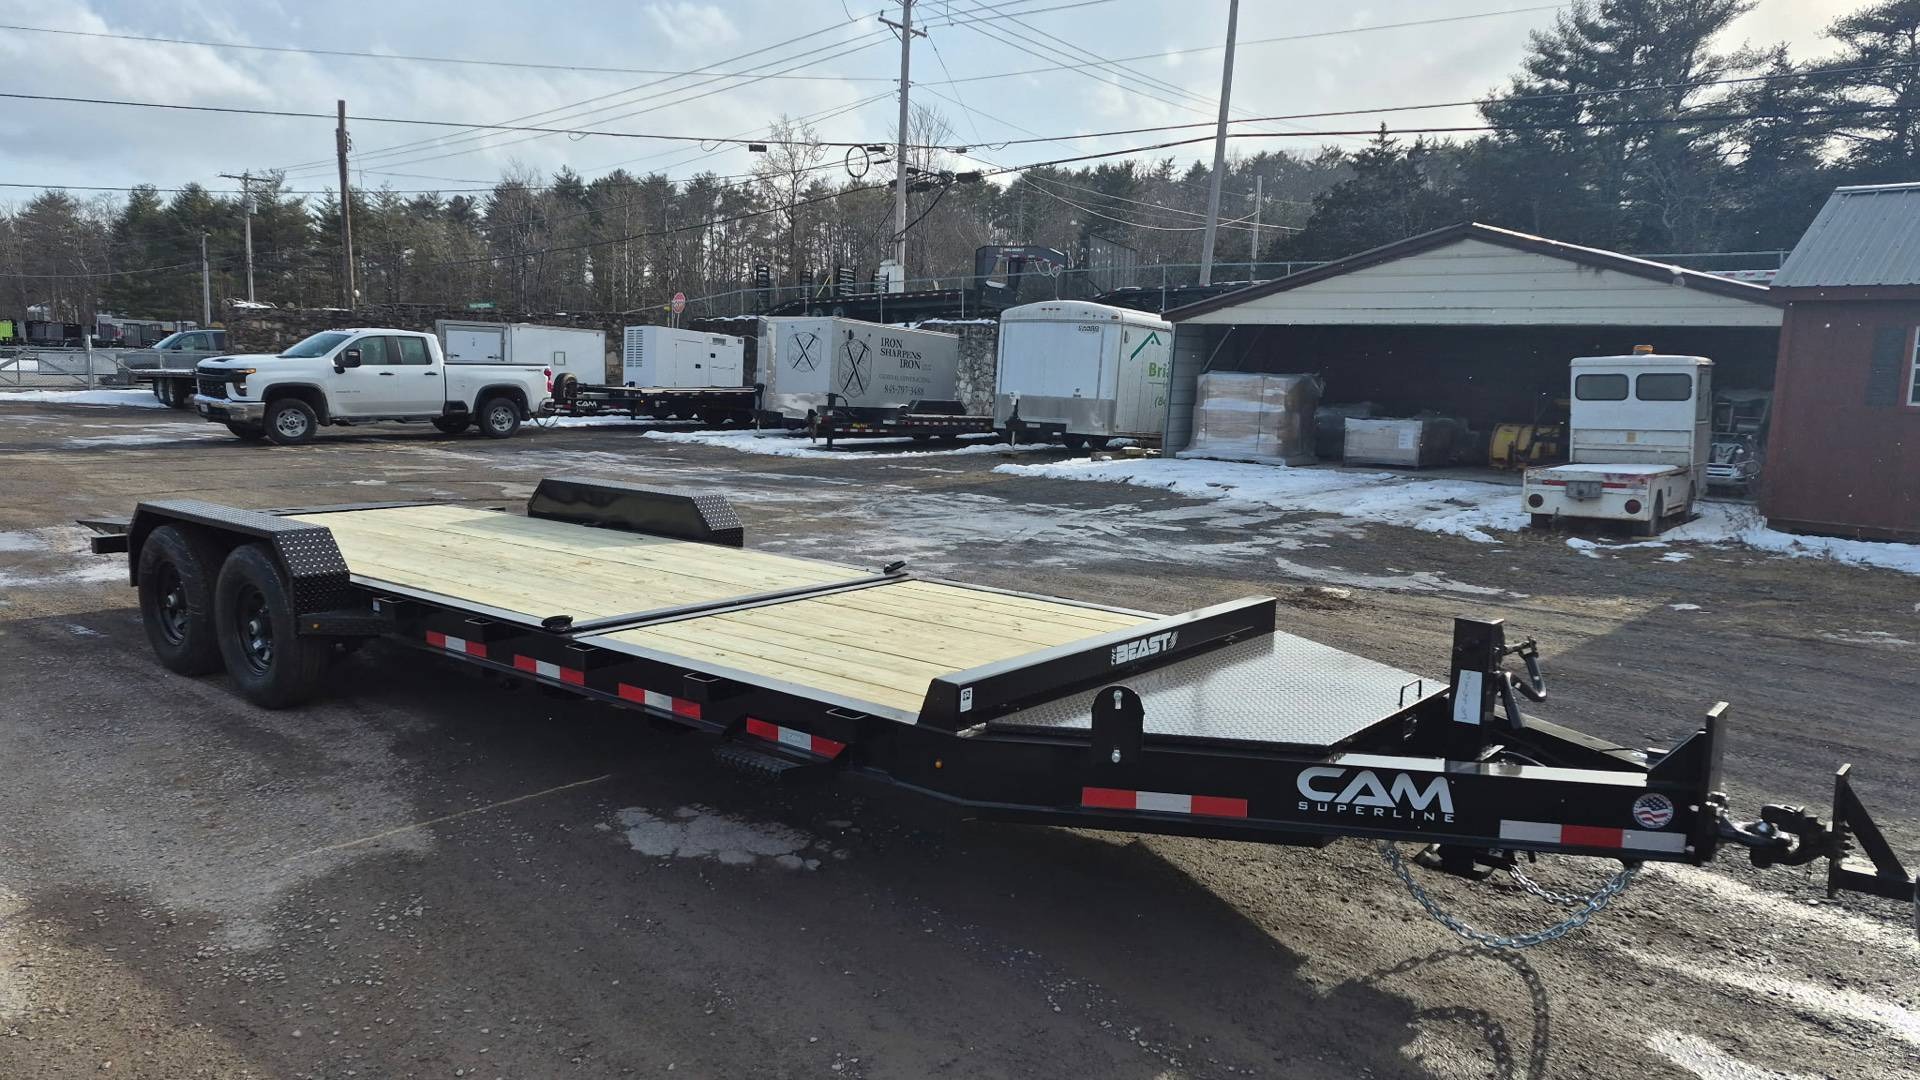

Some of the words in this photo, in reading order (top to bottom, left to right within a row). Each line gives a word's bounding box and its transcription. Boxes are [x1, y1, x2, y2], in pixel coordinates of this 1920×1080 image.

[881, 337, 903, 348] IRON
[880, 348, 921, 360] SHARPENS
[900, 359, 920, 369] IRON
[576, 400, 597, 408] CAM
[1116, 632, 1172, 665] BEAST
[1296, 766, 1455, 814] CAM
[1298, 801, 1455, 823] SUPERLINE
